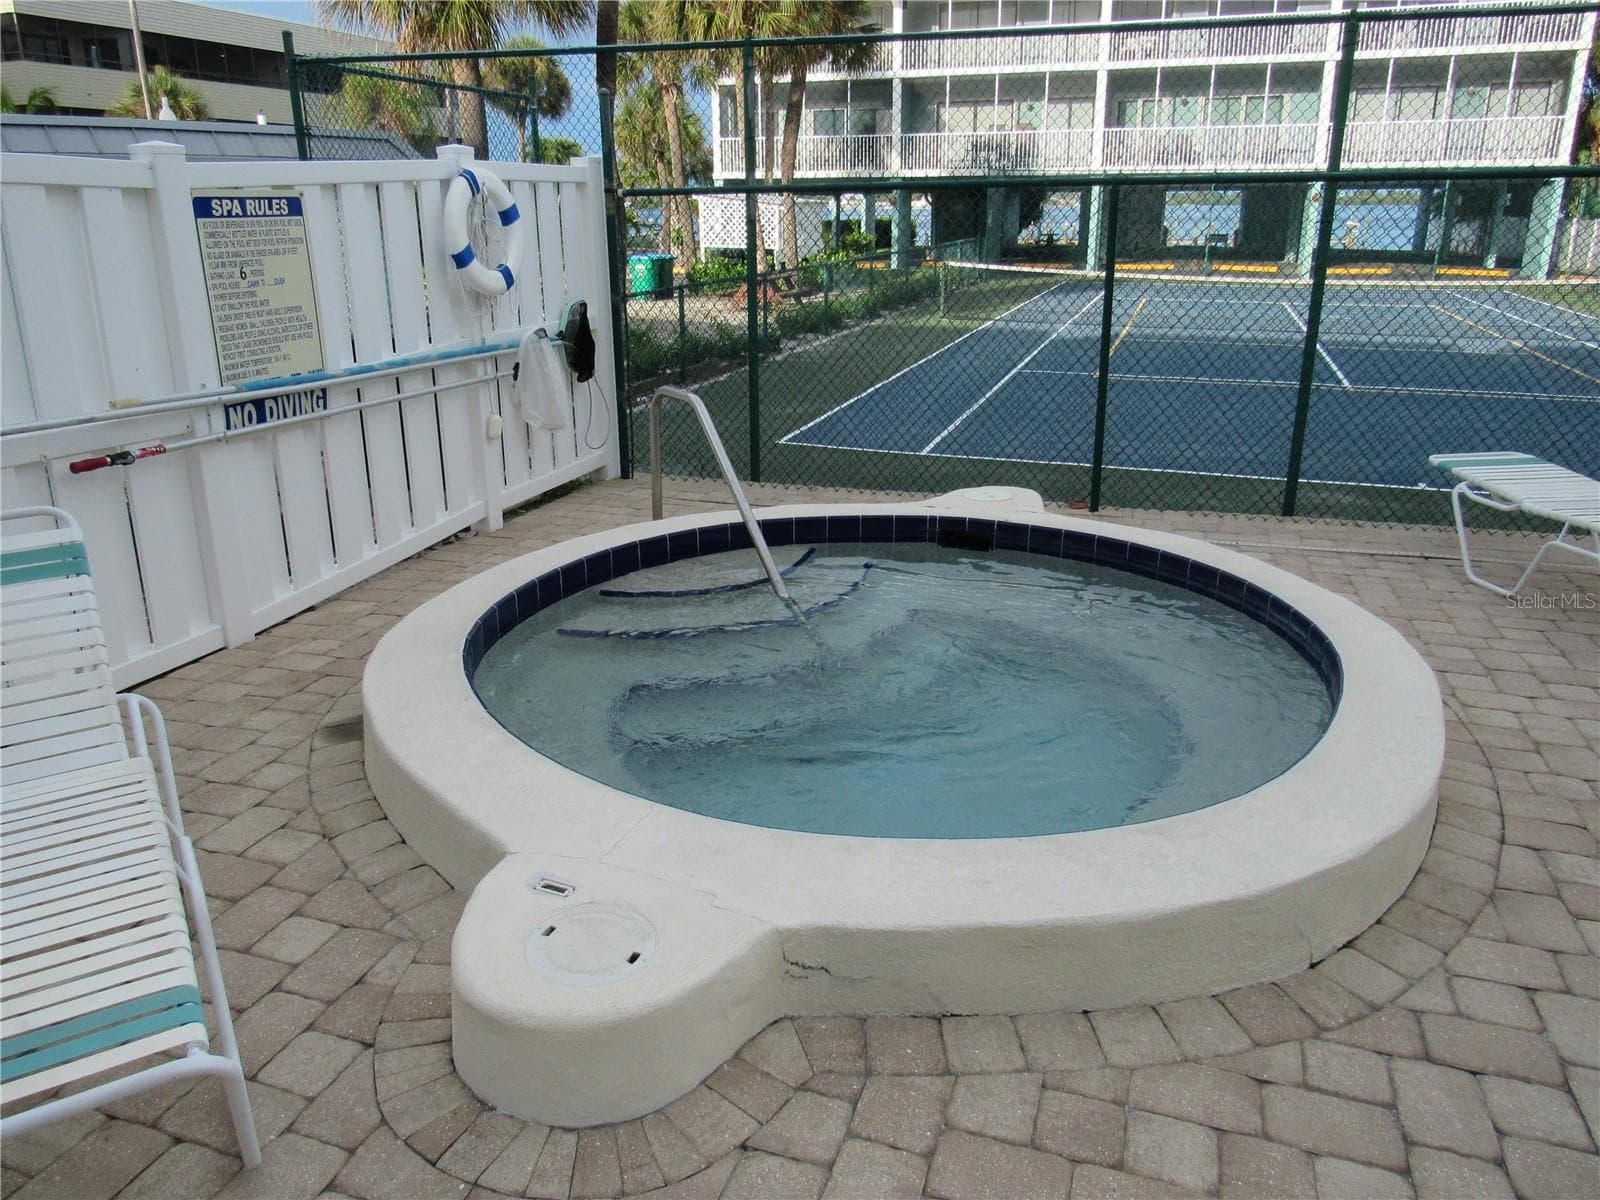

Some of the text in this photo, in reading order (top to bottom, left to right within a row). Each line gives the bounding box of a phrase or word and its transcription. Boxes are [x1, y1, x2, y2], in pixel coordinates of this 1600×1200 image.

[212, 199, 289, 216] SPA RULES
[240, 265, 247, 280] 6
[229, 389, 323, 430] NO DIVING
